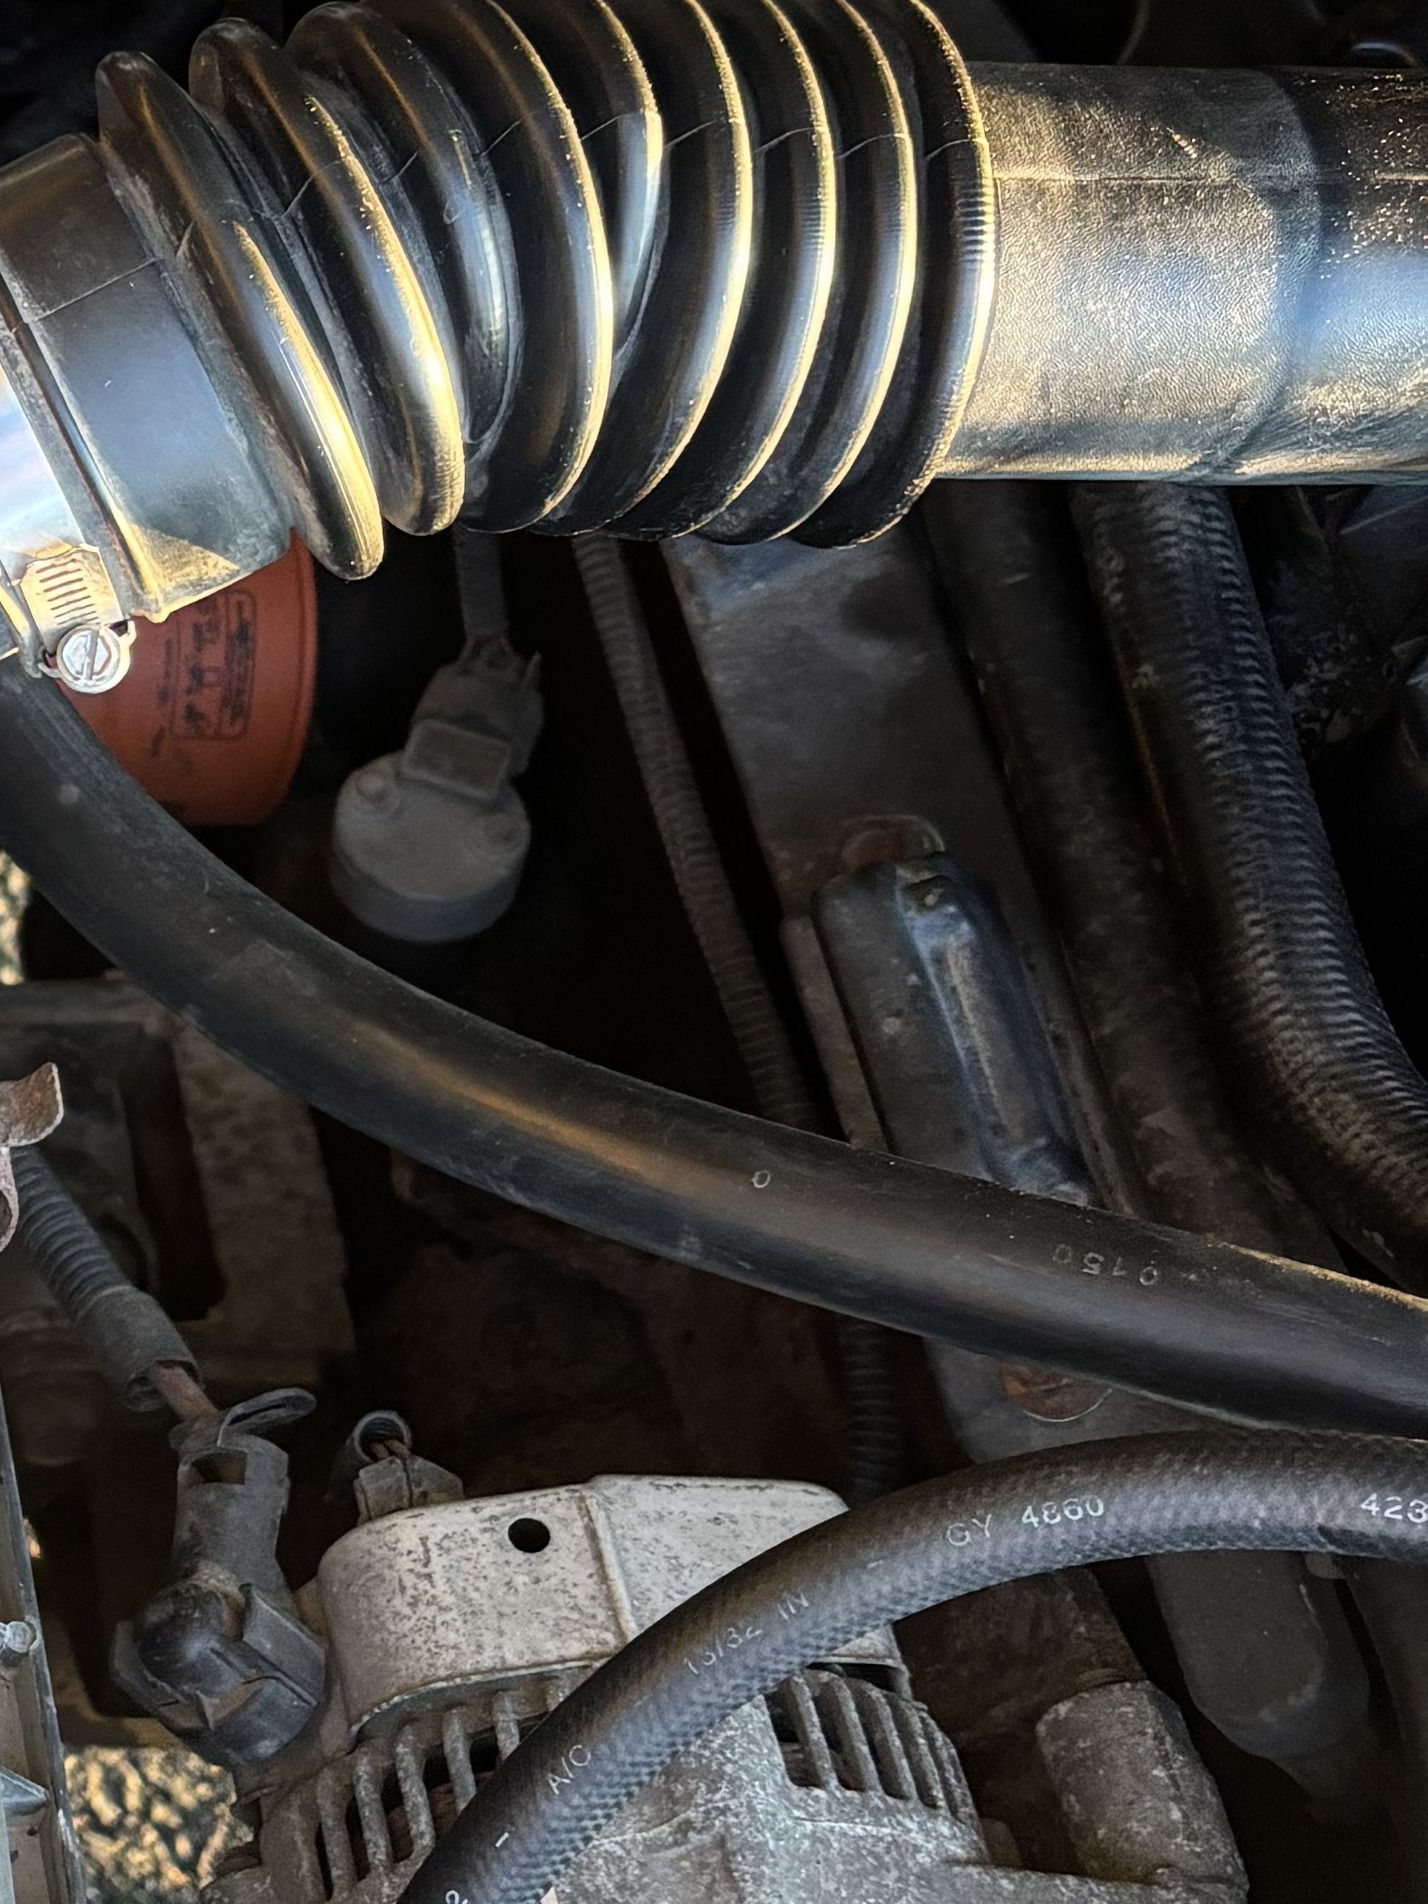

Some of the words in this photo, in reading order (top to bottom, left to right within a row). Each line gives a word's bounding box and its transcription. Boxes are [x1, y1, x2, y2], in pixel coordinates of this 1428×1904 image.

[945, 1515, 995, 1548] GY
[1021, 1496, 1106, 1529] 4860
[546, 1742, 594, 1798] A/C
